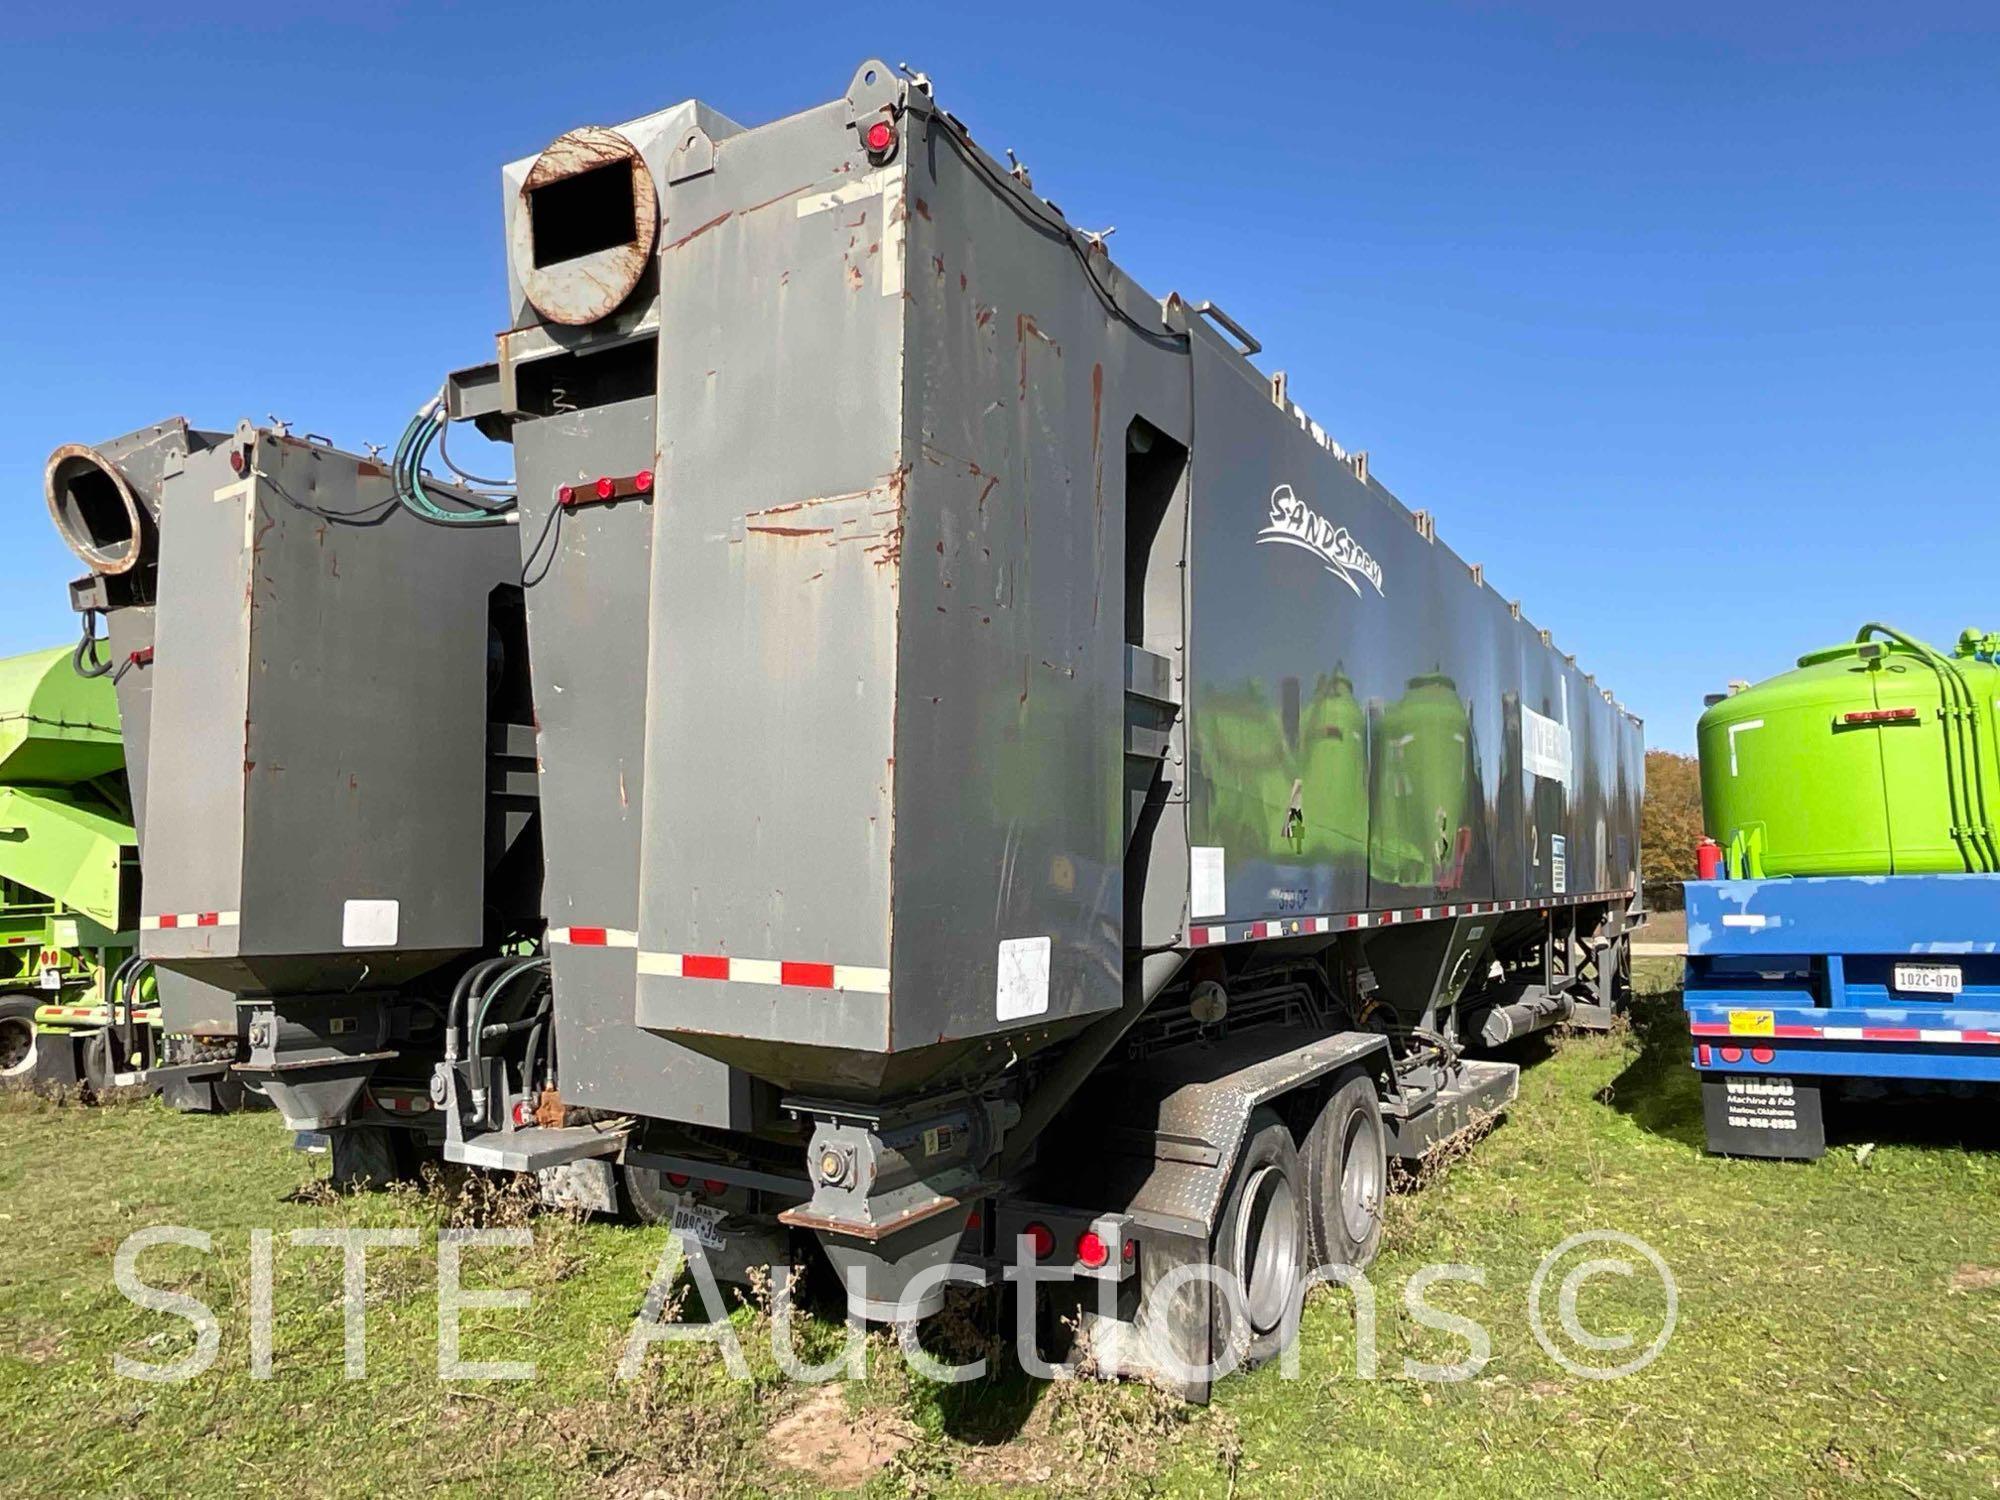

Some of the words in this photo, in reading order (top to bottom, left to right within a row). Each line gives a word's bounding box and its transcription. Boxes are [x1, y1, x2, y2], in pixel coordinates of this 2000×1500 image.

[1270, 484, 1383, 590] SANDSTORM
[1725, 1076, 1794, 1096] WILCO
[1727, 1095, 1767, 1105] Machine
[1768, 1097, 1776, 1106] &
[1777, 1097, 1796, 1107] Fab
